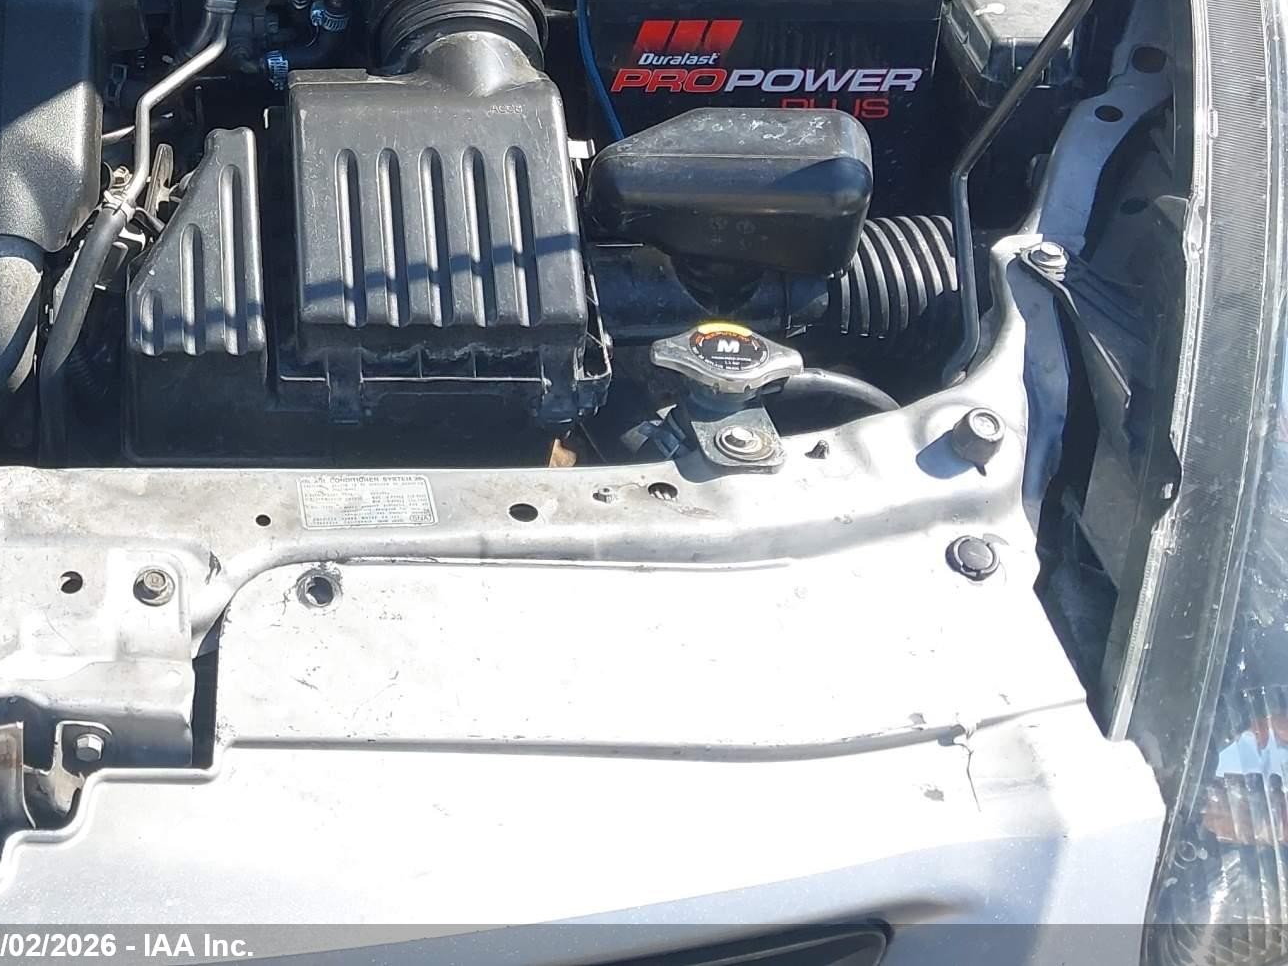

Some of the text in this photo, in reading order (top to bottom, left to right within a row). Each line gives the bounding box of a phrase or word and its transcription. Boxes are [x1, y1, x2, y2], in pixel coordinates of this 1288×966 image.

[638, 52, 720, 66] Duralast
[611, 67, 924, 93] PROPOWER
[717, 338, 740, 353] M
